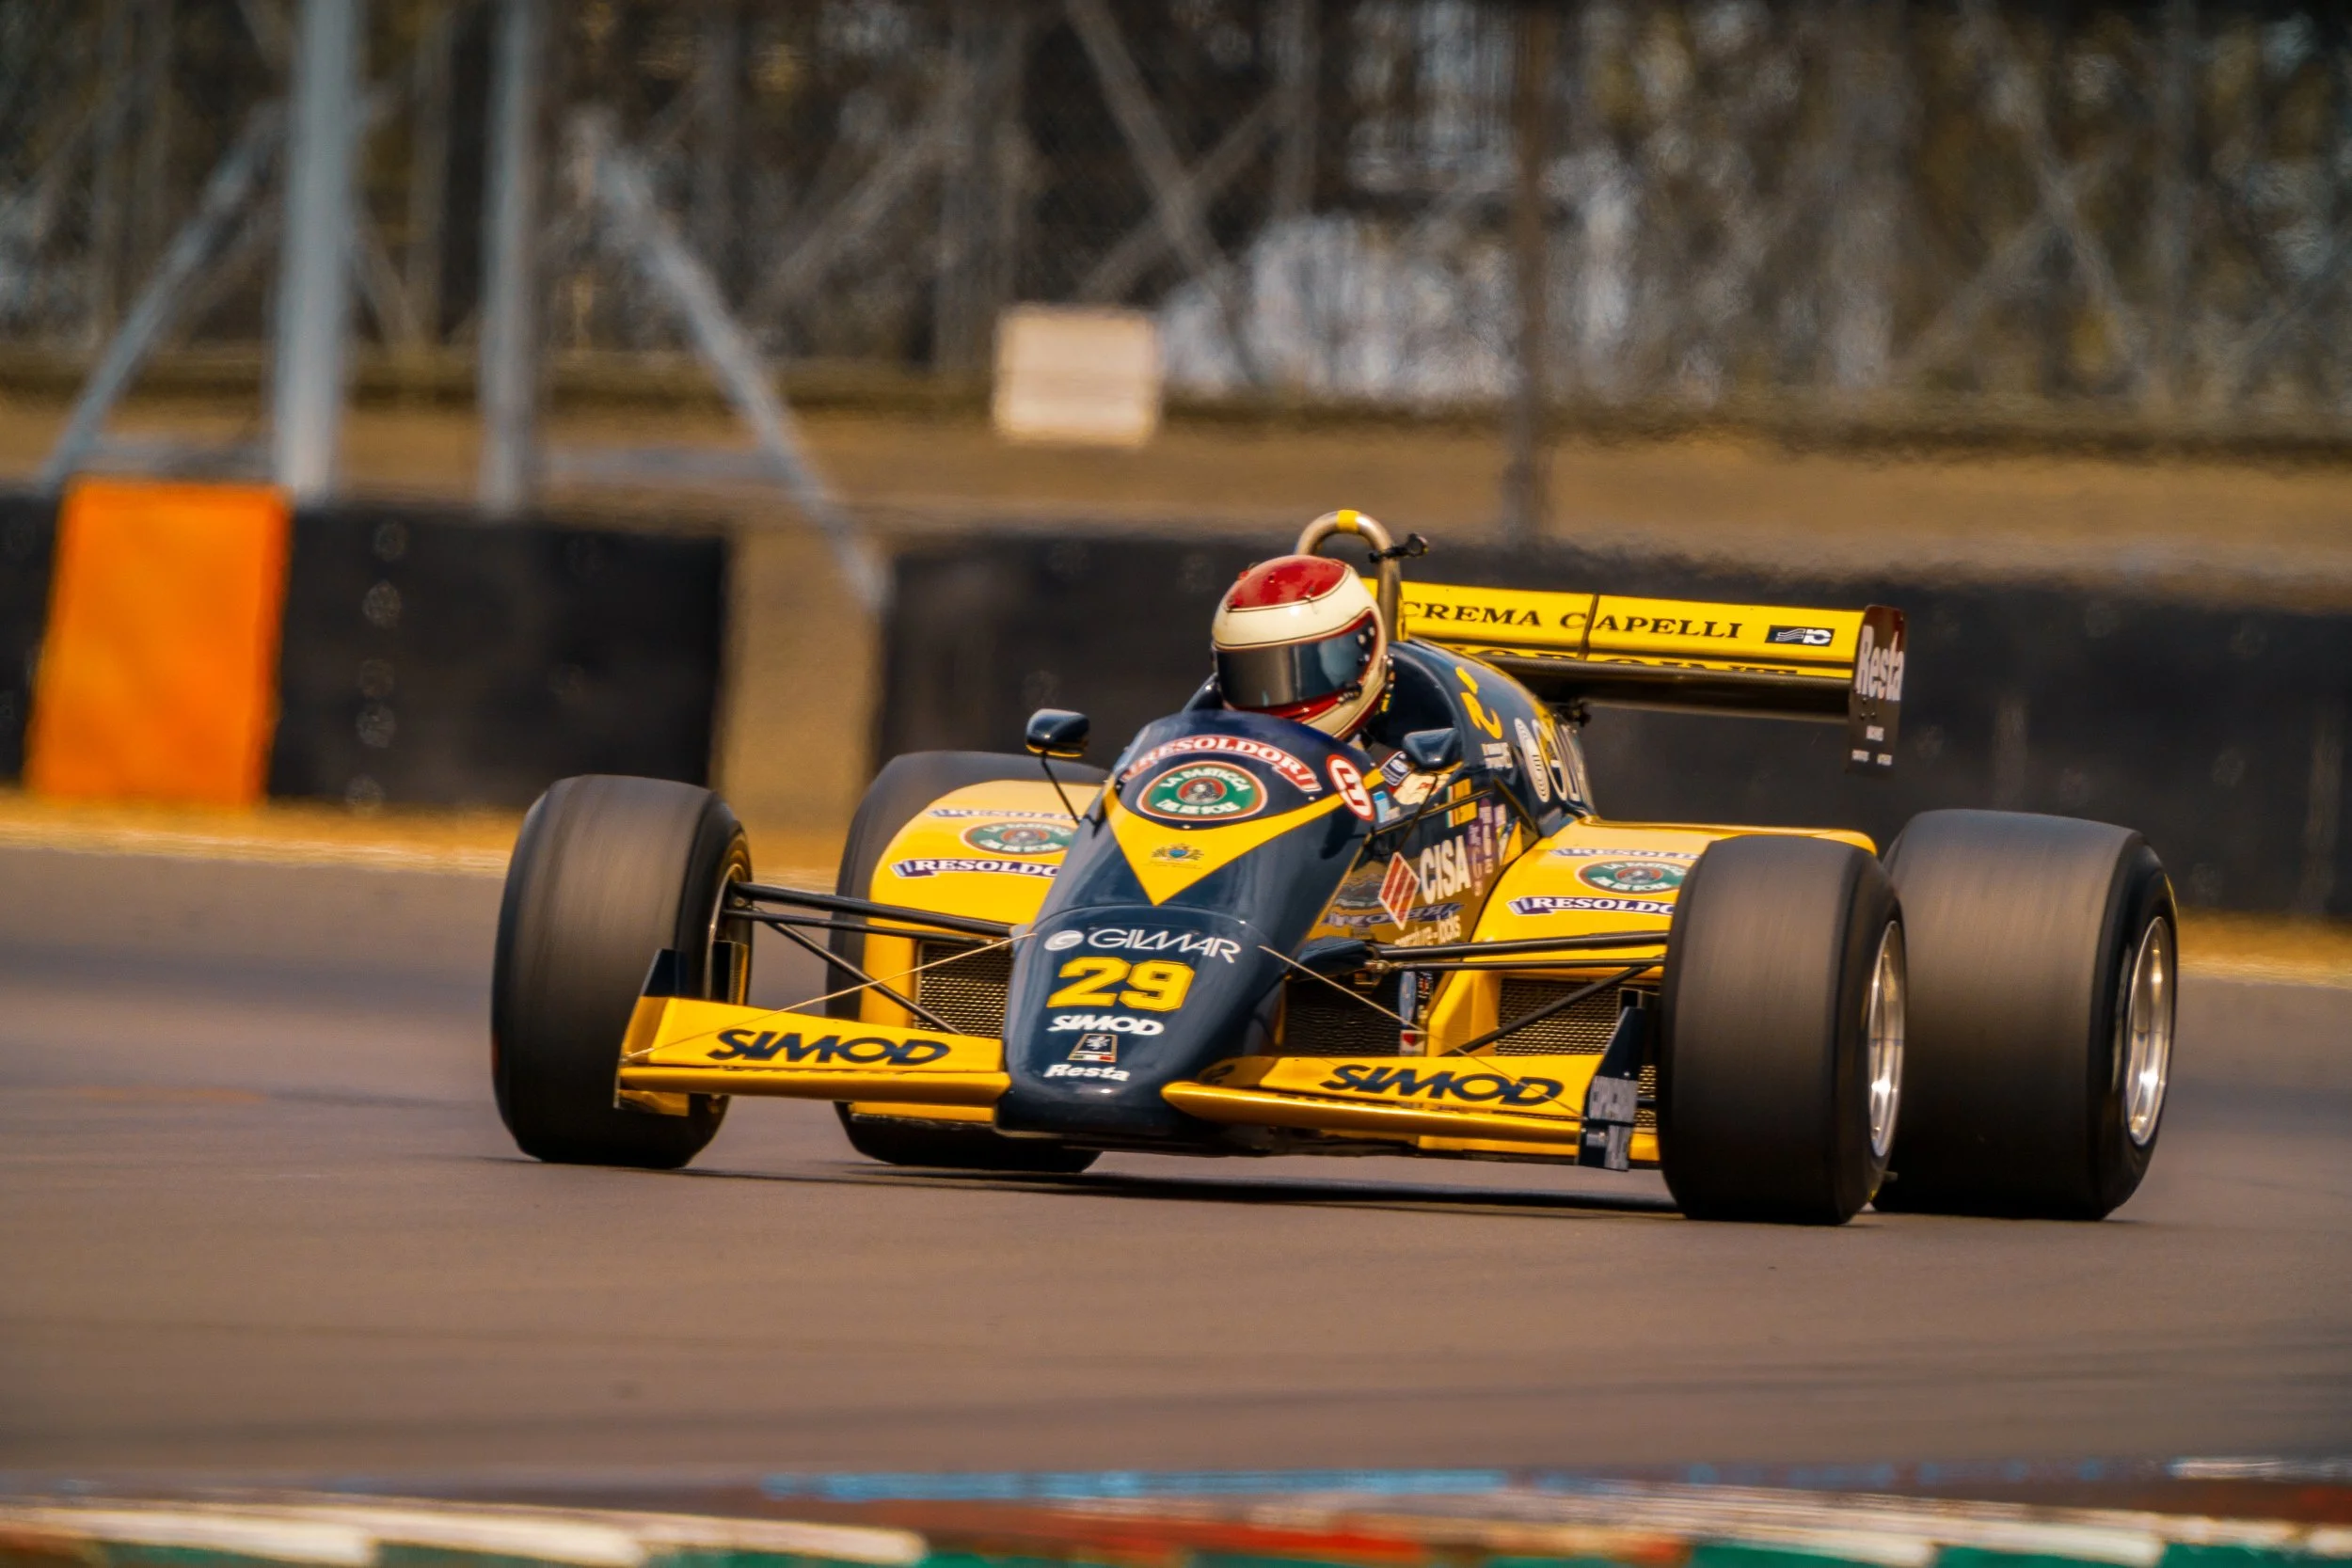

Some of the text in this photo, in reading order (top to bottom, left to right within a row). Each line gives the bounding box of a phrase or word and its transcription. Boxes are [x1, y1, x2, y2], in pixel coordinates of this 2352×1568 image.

[1402, 600, 1743, 640] CREMA CAPELLI
[1854, 624, 1905, 702] Resta
[1420, 834, 1472, 905] CISA
[1088, 928, 1242, 963] GILMAR
[1046, 956, 1196, 1012] 29
[1046, 1014, 1165, 1036] SIMOD
[707, 1028, 951, 1066] SIMOD
[1042, 1064, 1131, 1082] Resta
[1319, 1063, 1565, 1106] SIMOD
